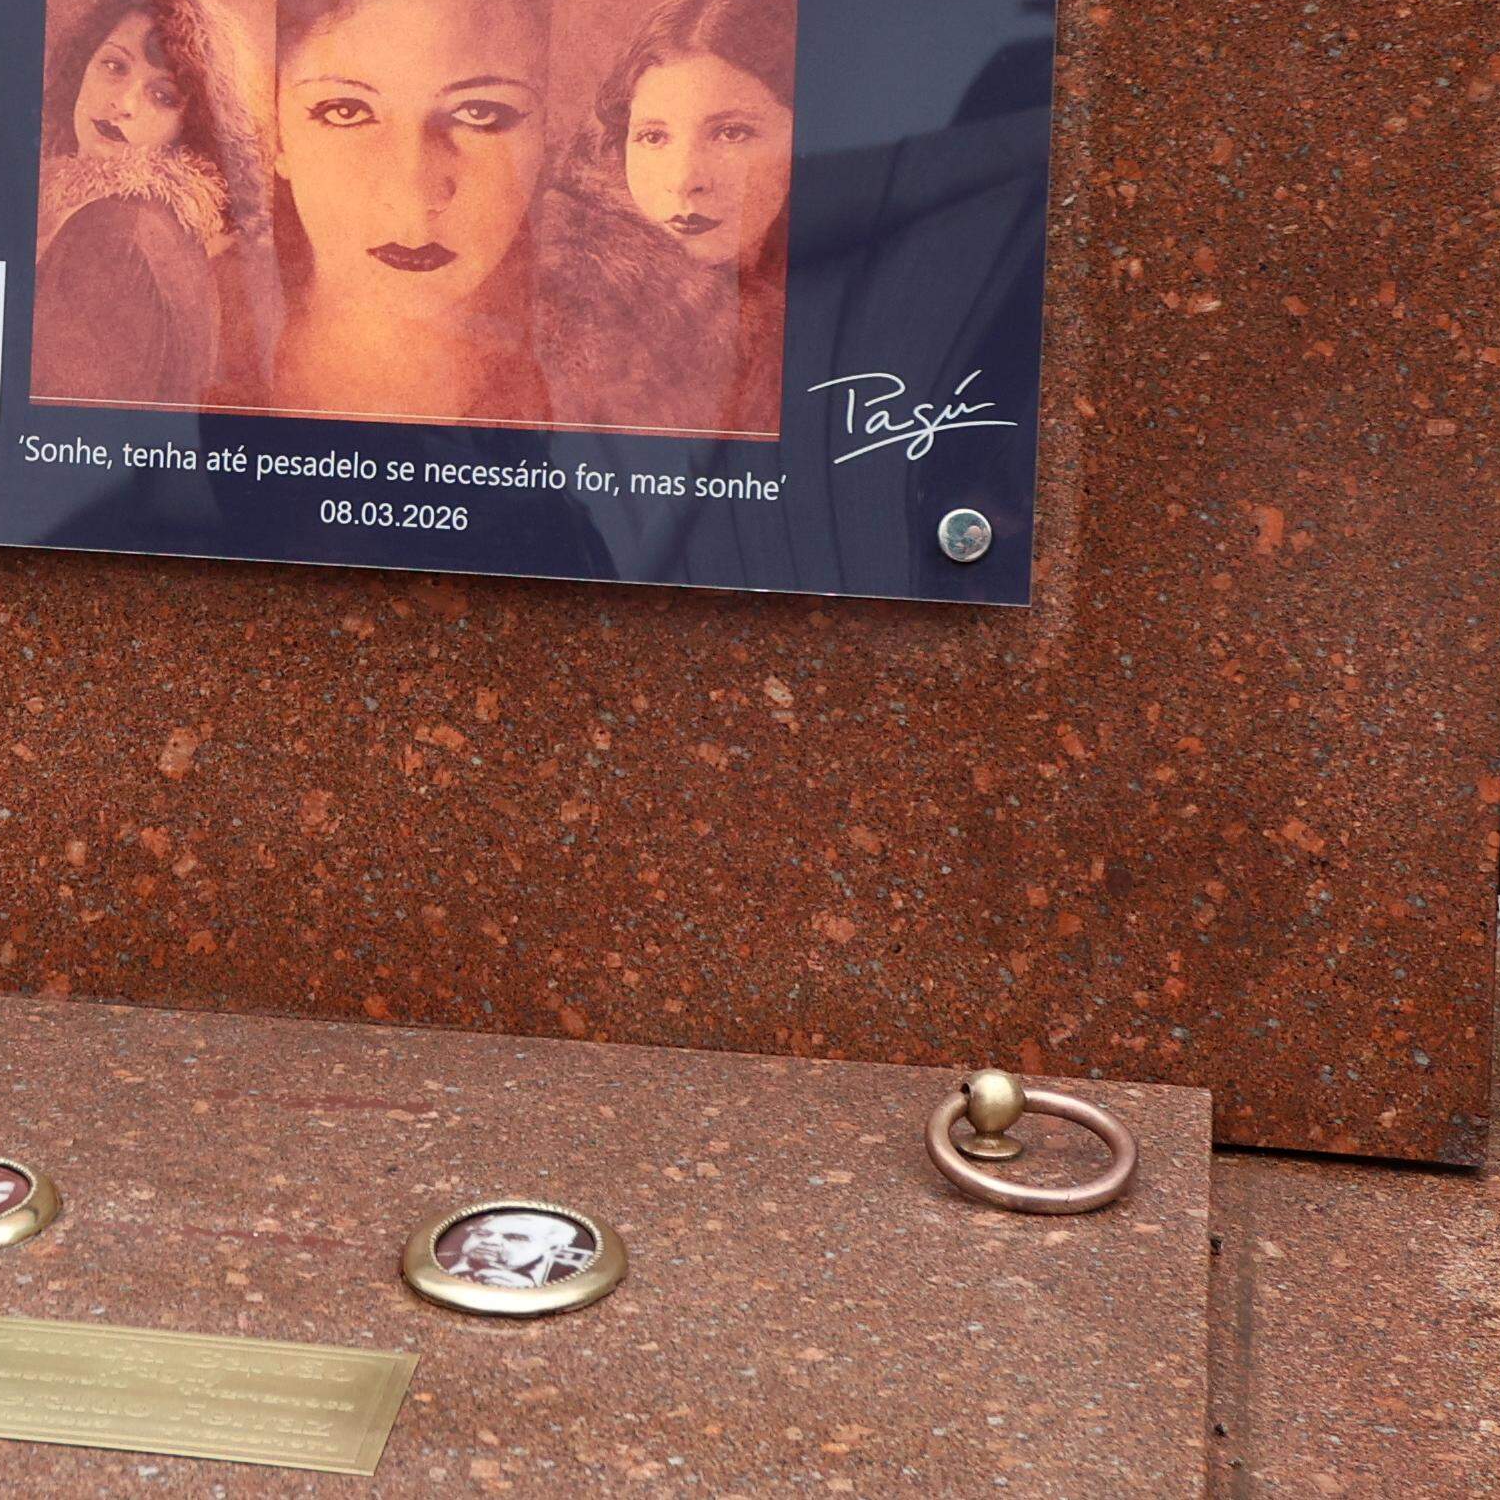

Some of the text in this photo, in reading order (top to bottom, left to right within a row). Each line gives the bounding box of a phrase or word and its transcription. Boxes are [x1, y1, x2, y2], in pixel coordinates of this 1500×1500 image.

[122, 442, 197, 471] tenha
[206, 444, 248, 473] até
[256, 450, 377, 482] pesadelo
[386, 459, 415, 482] se
[424, 459, 567, 490] necessário
[575, 462, 620, 497] for,
[630, 471, 687, 497] mas
[319, 499, 469, 531] 08.03.2026
